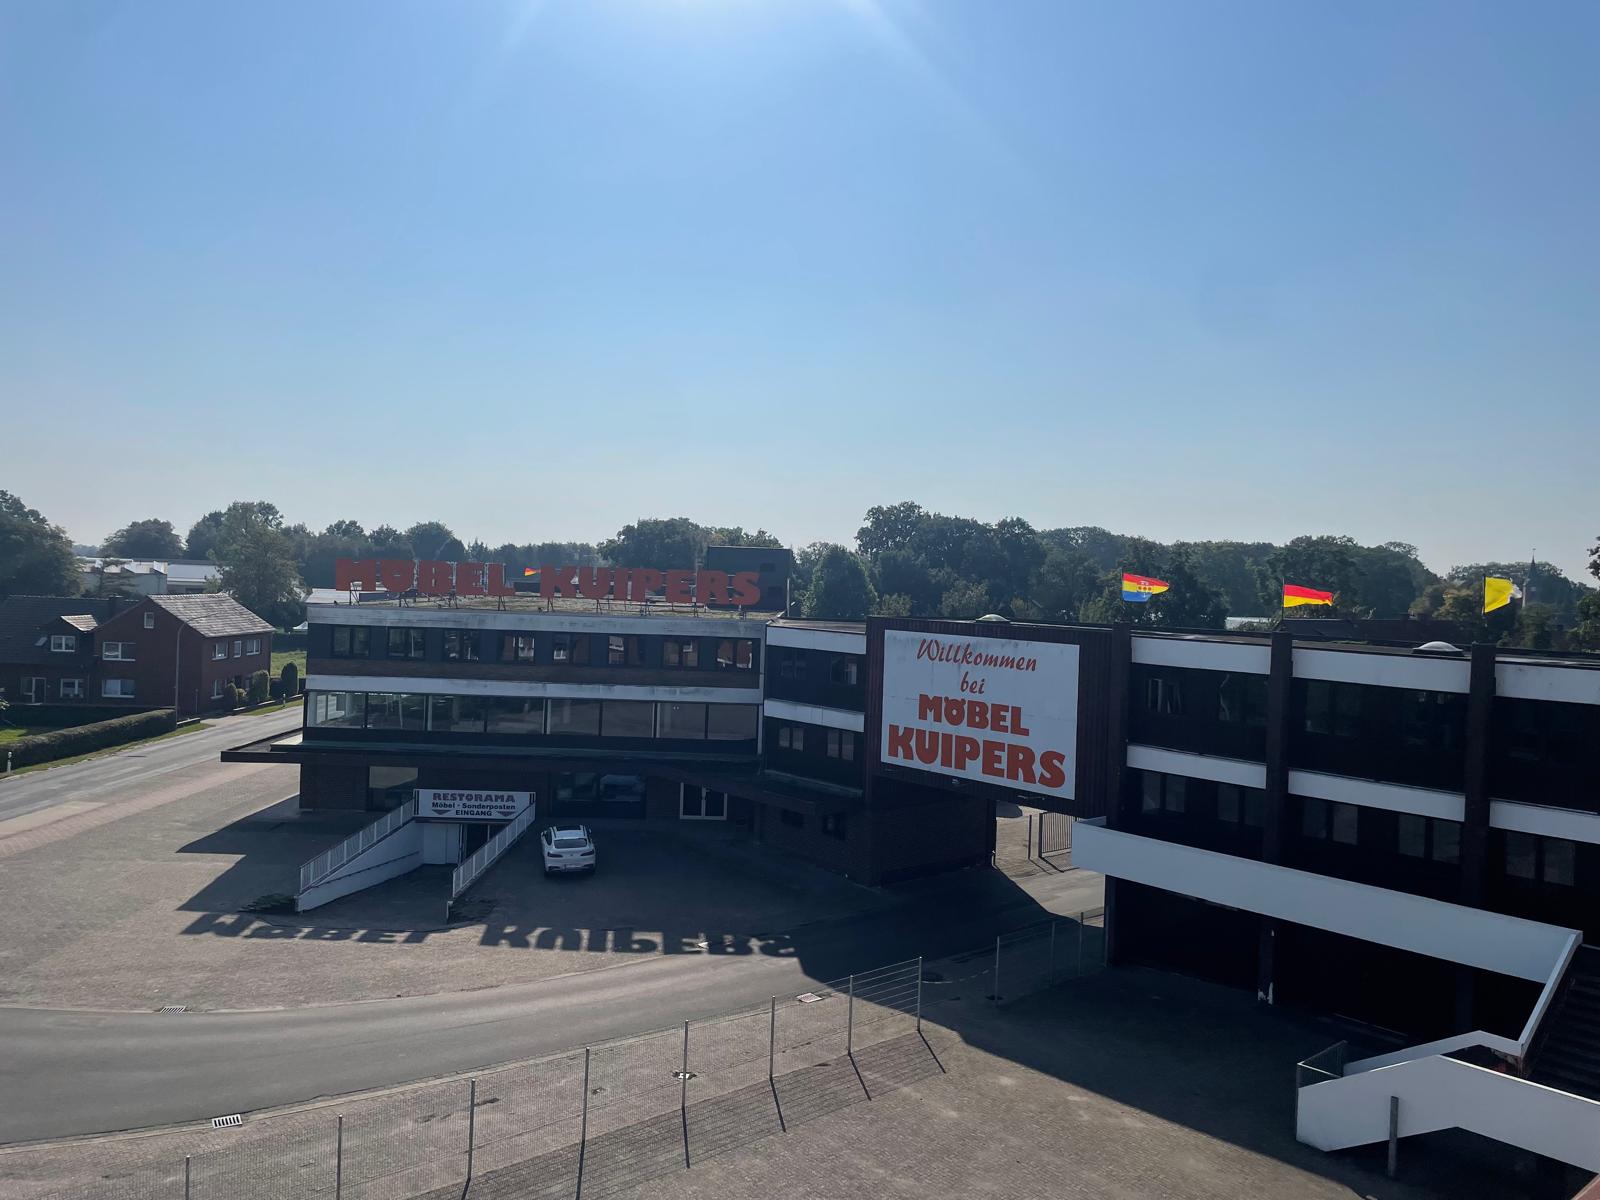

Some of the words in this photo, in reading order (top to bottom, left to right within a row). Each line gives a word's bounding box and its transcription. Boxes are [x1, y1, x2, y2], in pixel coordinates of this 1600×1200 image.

[539, 565, 761, 605] KUIPERS
[917, 638, 1037, 671] Willkommen
[960, 671, 985, 694] bei
[918, 693, 1030, 736] MÖBEL
[887, 723, 1066, 788] KUIPERS
[432, 792, 516, 802] RESTORAMA
